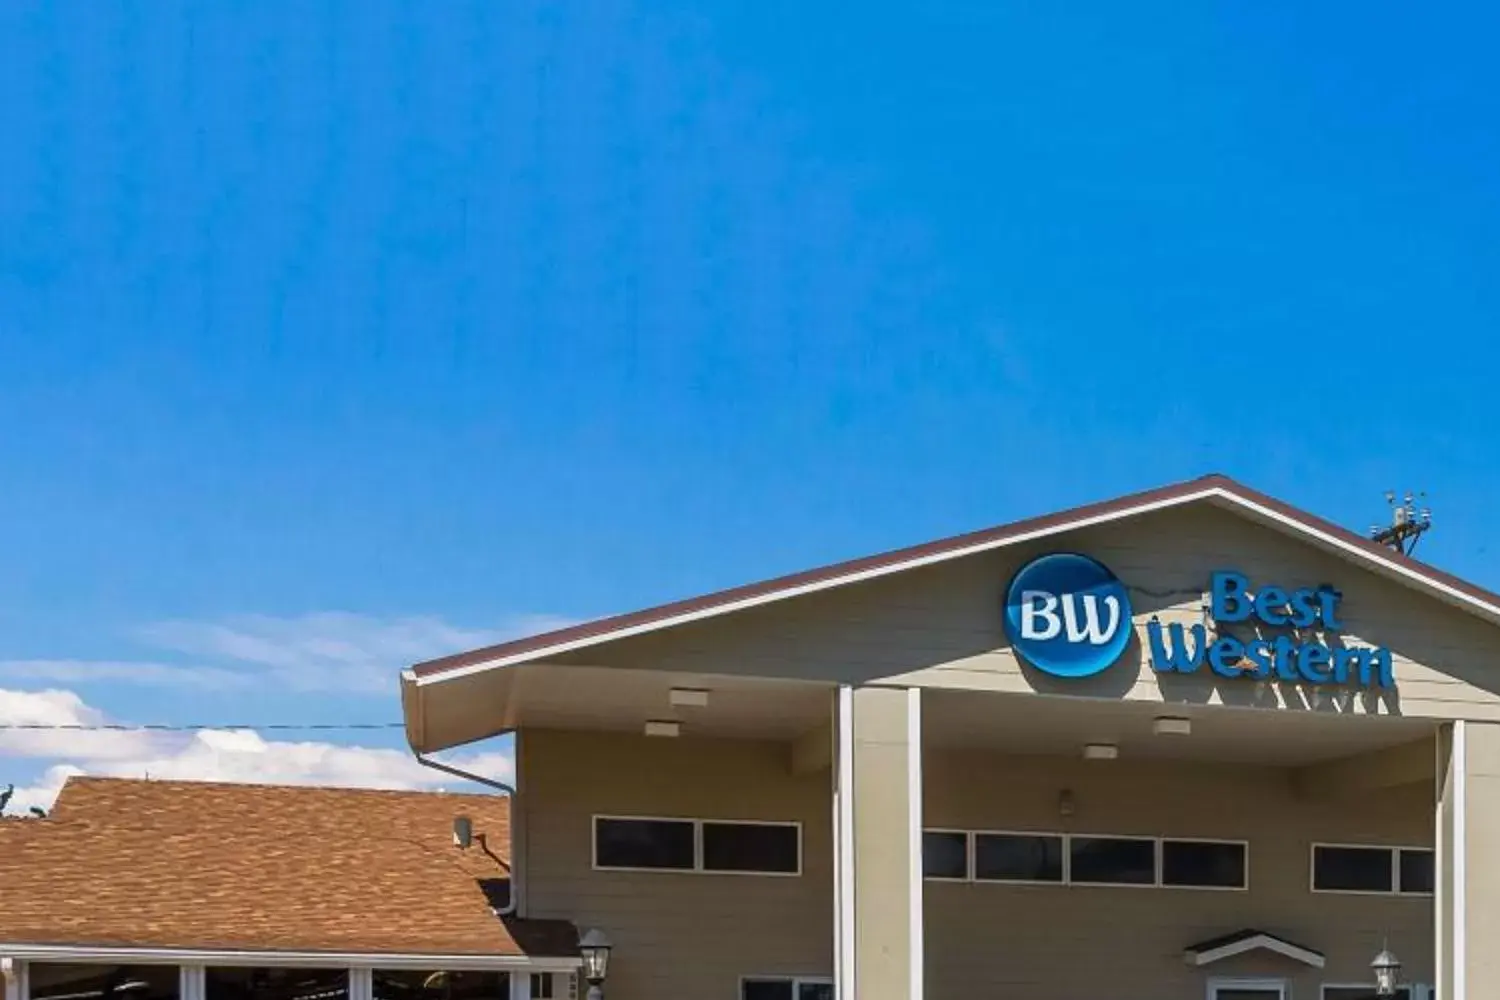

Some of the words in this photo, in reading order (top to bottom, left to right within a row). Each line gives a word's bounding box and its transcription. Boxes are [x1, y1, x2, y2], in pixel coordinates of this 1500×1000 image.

[1021, 590, 1120, 645] BW
[1210, 570, 1343, 632] Best
[1146, 619, 1394, 689] Western
